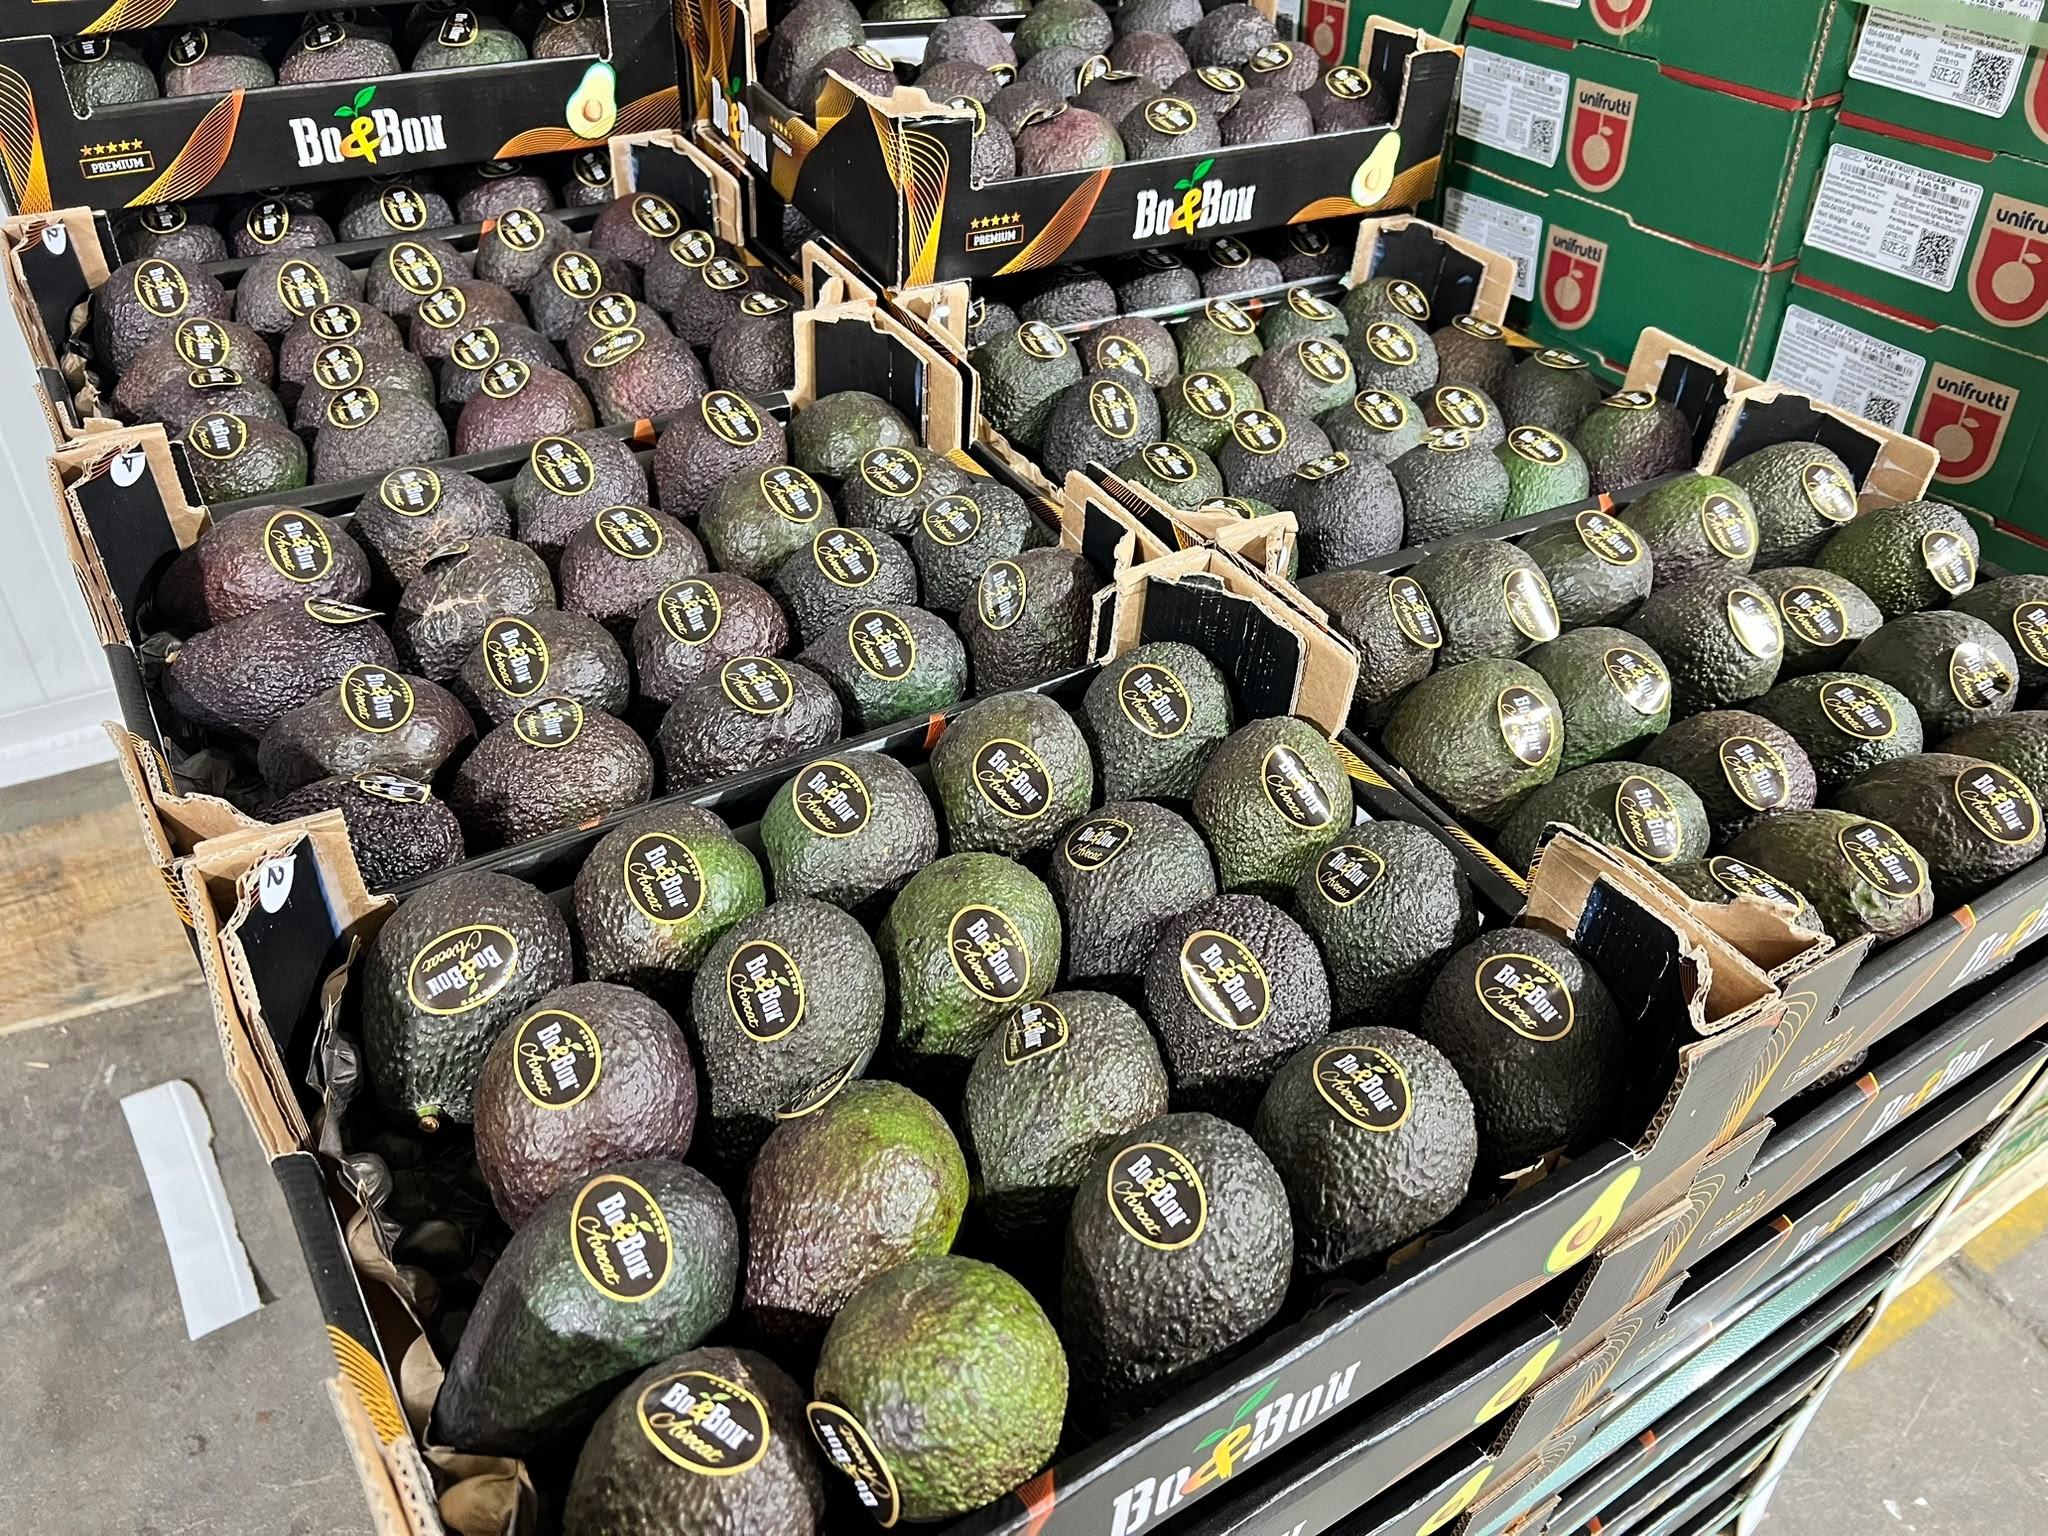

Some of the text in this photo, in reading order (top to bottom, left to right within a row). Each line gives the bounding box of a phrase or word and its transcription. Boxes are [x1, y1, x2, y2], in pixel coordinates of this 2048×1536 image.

[1580, 91, 1632, 116] unifrutti
[91, 157, 144, 174] PREMIUM
[973, 229, 1017, 247] PREMIUM
[1553, 235, 1602, 262] unifrutti
[1936, 376, 2010, 412] unifrutti
[1110, 1360, 1362, 1536] Bo&Bon
